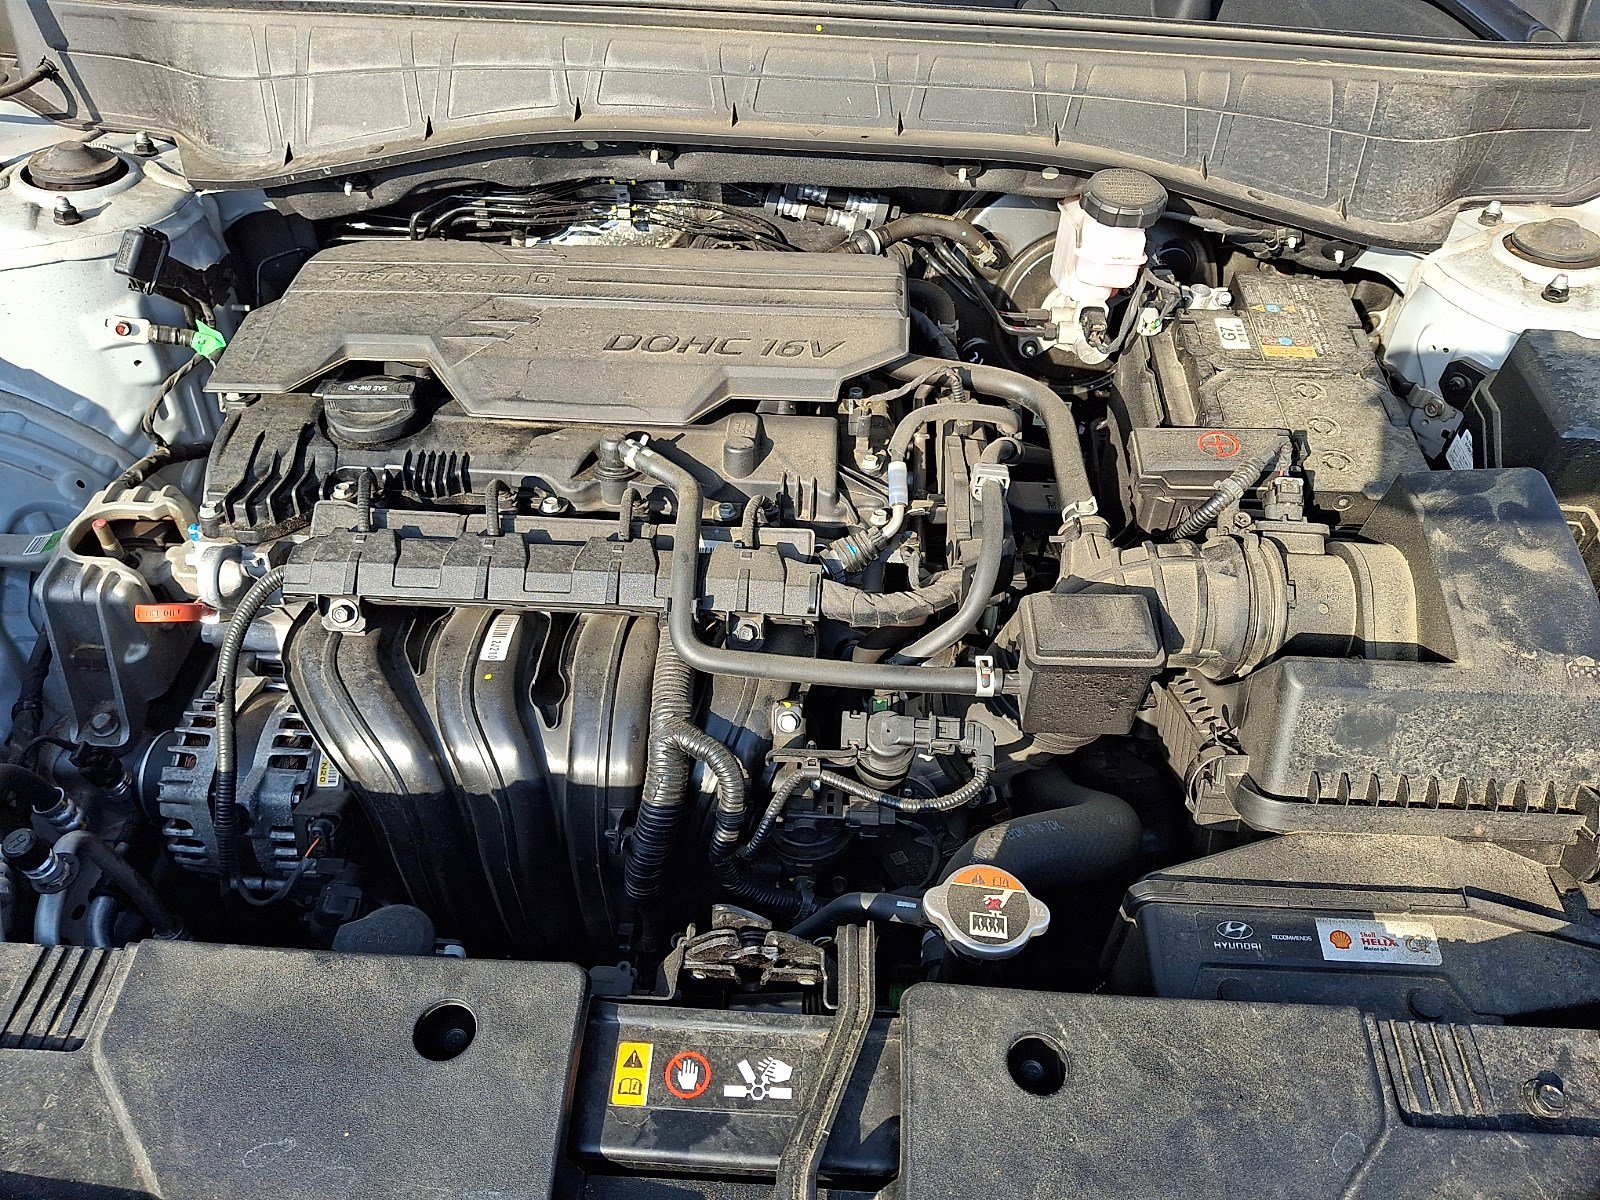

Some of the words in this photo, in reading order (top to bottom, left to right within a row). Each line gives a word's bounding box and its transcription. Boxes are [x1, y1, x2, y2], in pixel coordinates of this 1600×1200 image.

[602, 333, 751, 356] DOHC
[760, 338, 847, 358] 16V
[347, 384, 372, 392] 0W-20
[319, 762, 328, 783] N20
[1271, 934, 1313, 942] RECOMMENDS
[1361, 937, 1399, 948] HELIX
[1213, 941, 1262, 951] HYUNDAI
